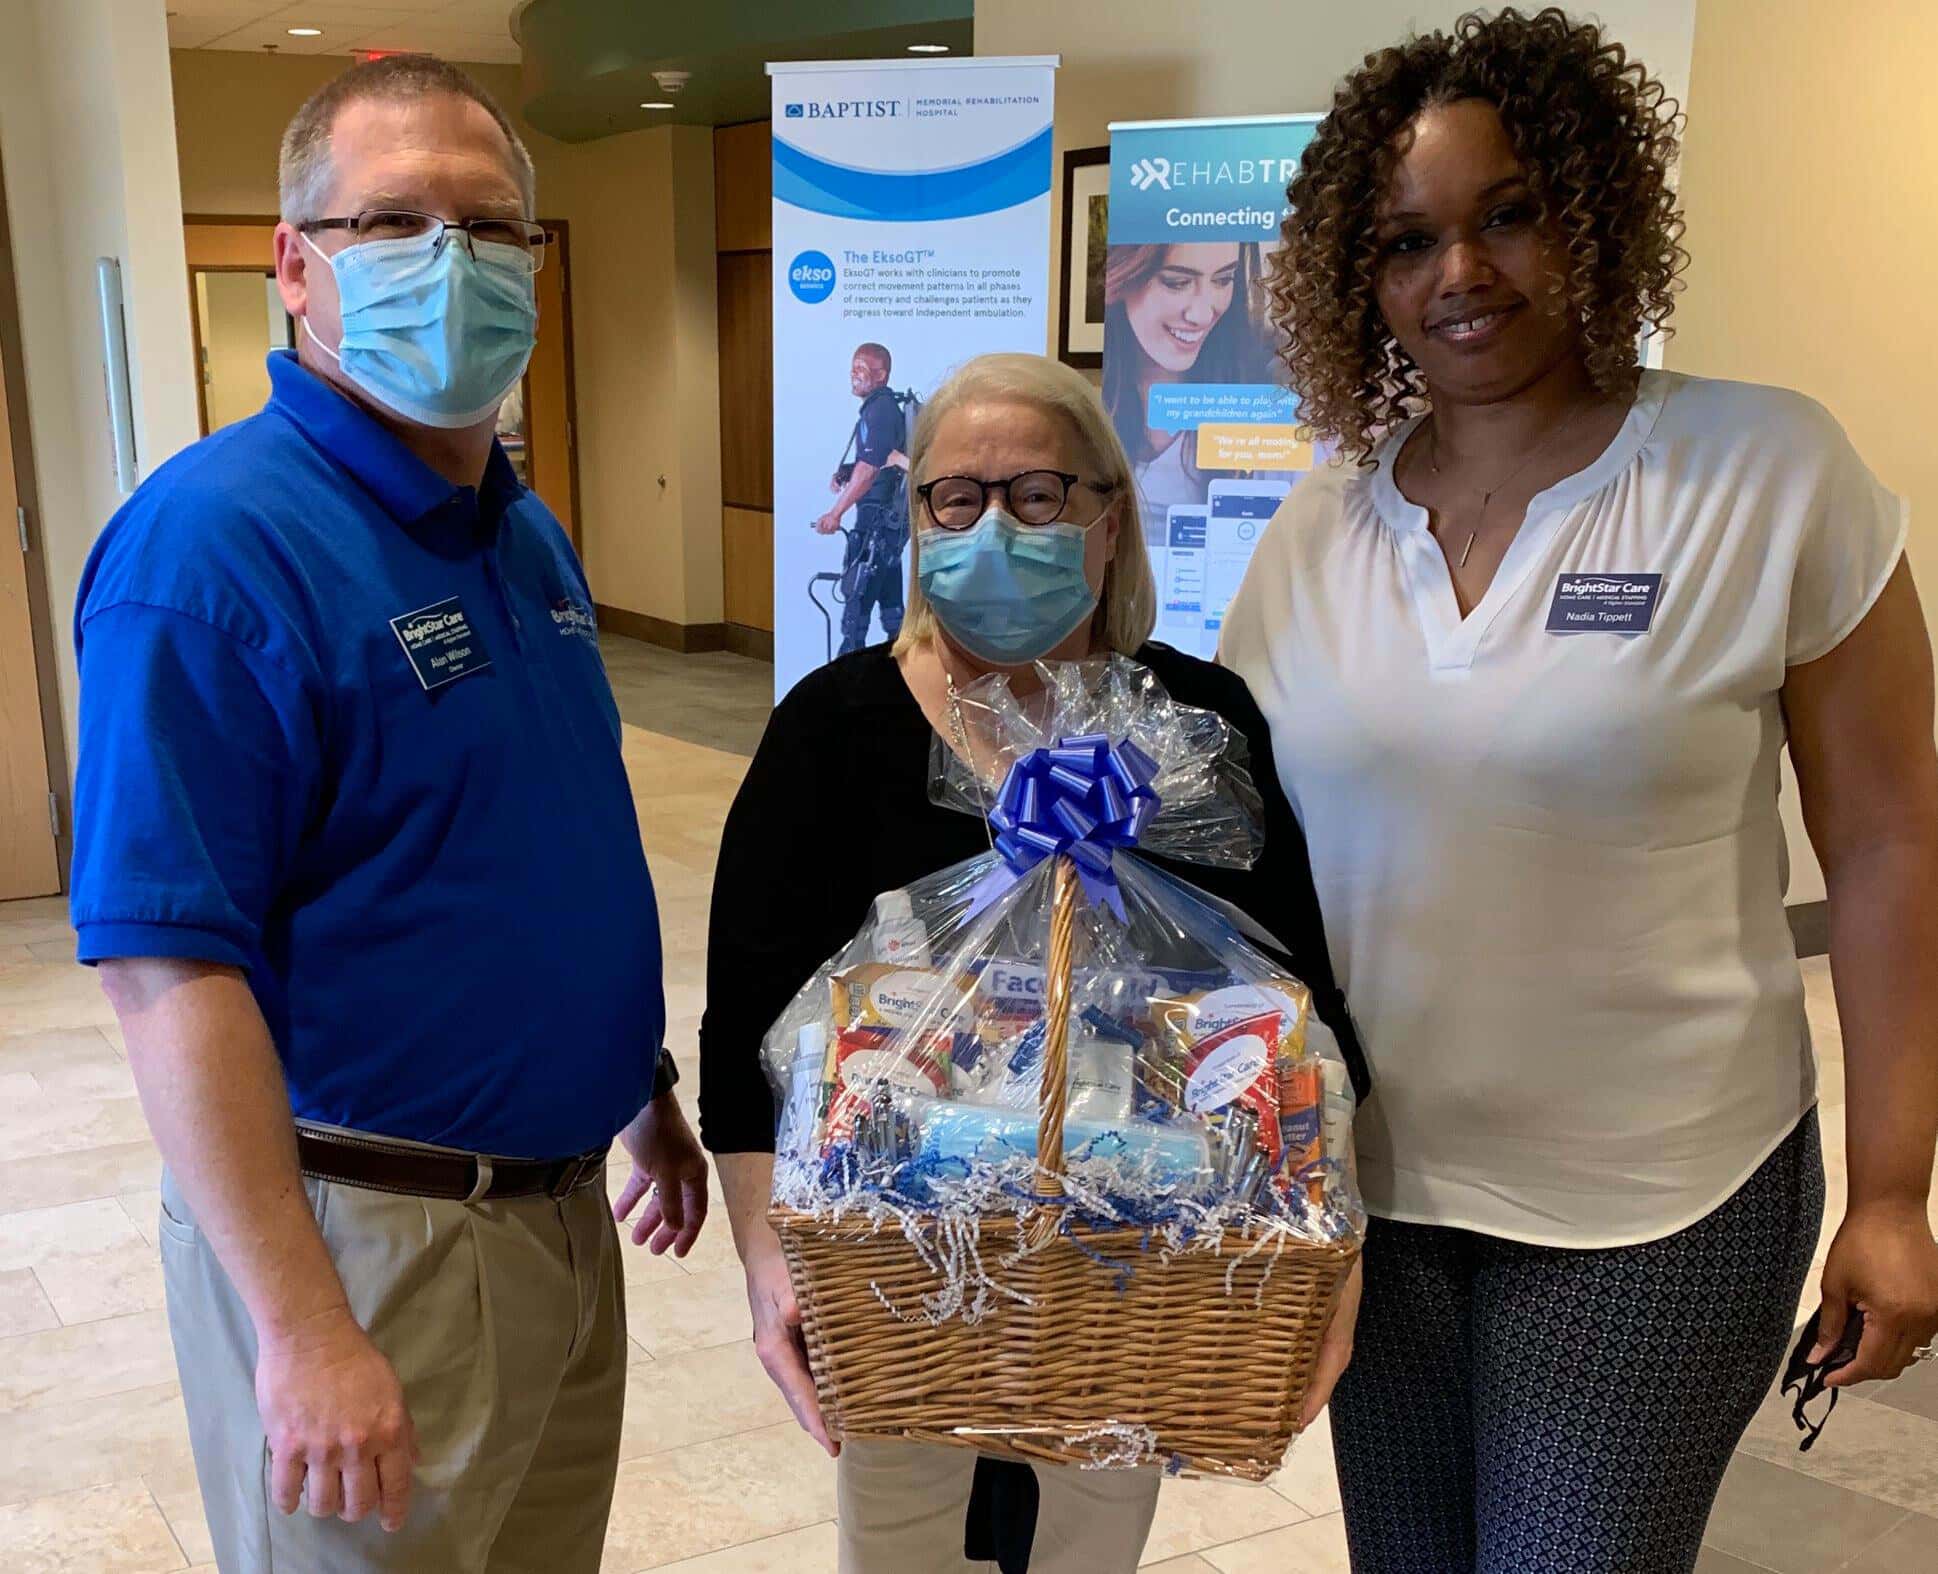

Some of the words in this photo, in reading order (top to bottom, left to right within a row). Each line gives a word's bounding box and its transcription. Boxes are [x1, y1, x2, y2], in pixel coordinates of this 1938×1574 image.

[916, 98, 961, 107] MEMORIAL
[966, 96, 1039, 105] REHABILITATION
[807, 101, 900, 118] BAPTIST
[916, 109, 959, 117] HOSPITAL
[1140, 157, 1298, 191] REHABTR
[1166, 207, 1275, 229] Connecting
[843, 251, 868, 264] The
[792, 265, 832, 282] ekso
[843, 268, 874, 278] EksoGT
[878, 269, 903, 278] works
[906, 268, 924, 278] with
[927, 267, 967, 278] clinicians
[970, 268, 979, 278] to
[982, 269, 1020, 279] promote
[843, 283, 875, 291] correct
[878, 283, 924, 291] movement
[927, 282, 963, 292] patterns
[967, 282, 974, 290] in
[977, 282, 987, 291] all
[990, 282, 1021, 292] phases
[843, 295, 852, 304] of
[855, 296, 893, 306] recovery
[896, 295, 911, 304] and
[914, 295, 960, 306] challenges
[962, 295, 997, 305] patients
[1000, 296, 1010, 304] as
[1013, 296, 1032, 306] they
[843, 309, 880, 319] progress
[883, 308, 913, 318] toward
[916, 308, 971, 319] independent
[1164, 396, 1187, 405] want
[1190, 395, 1201, 405] to
[1203, 394, 1215, 405] be
[1217, 394, 1238, 405] able
[1240, 396, 1251, 405] to
[1253, 395, 1273, 407] play
[1166, 408, 1181, 419] my
[1184, 407, 1248, 420] grandchildren
[1561, 582, 1620, 595] BrightStar
[1622, 582, 1650, 593] Care
[443, 611, 465, 627] Care
[1566, 612, 1595, 621] Nadia
[1598, 611, 1633, 624] Tippett
[430, 655, 449, 669] Alan
[991, 969, 1045, 995] Fac
